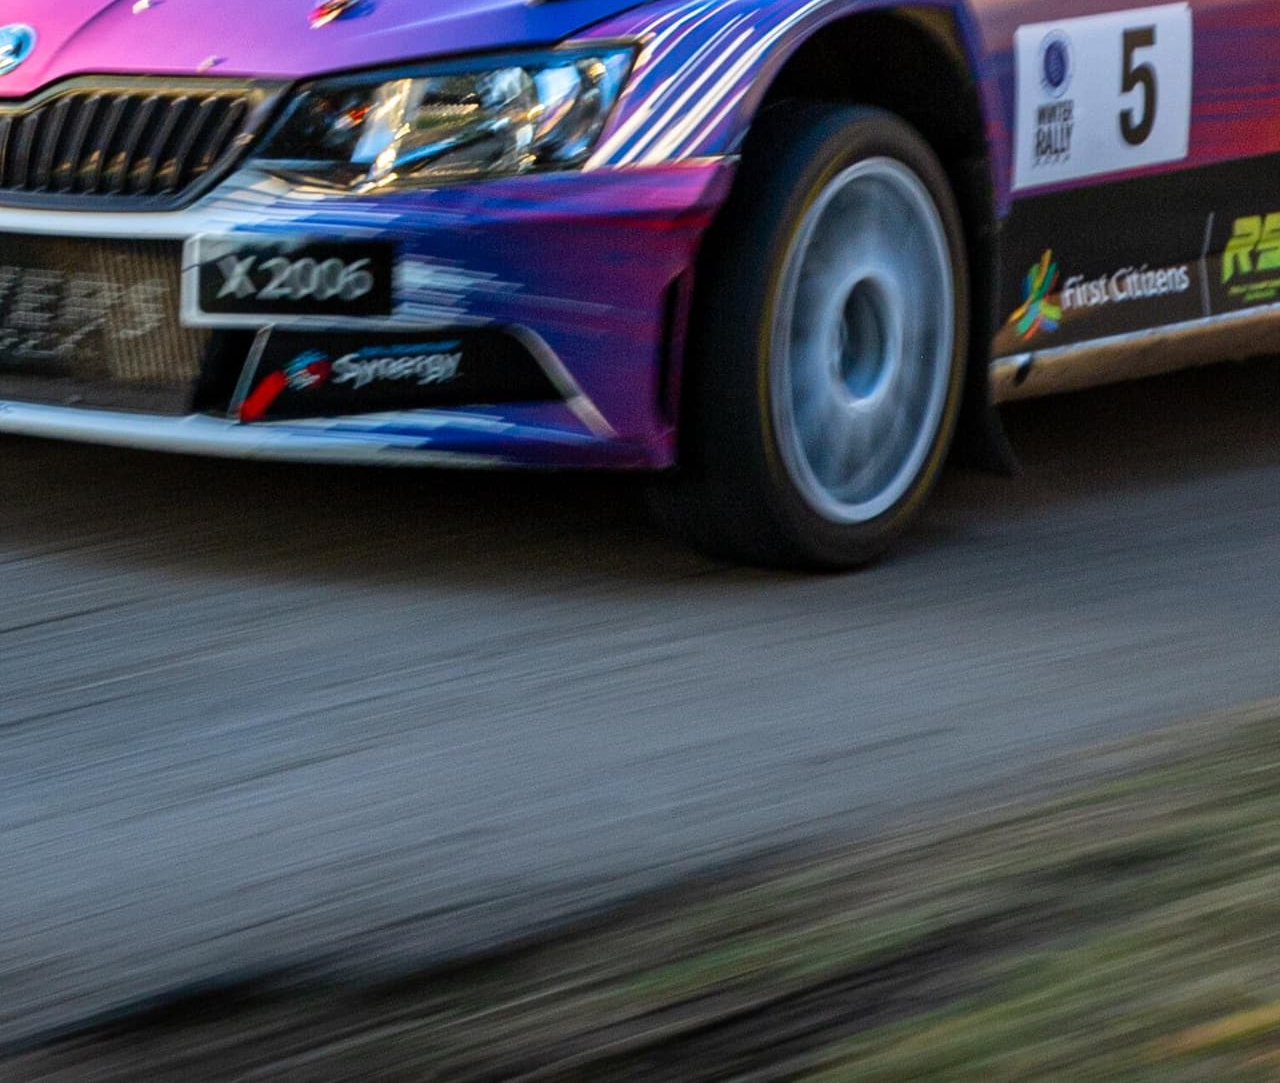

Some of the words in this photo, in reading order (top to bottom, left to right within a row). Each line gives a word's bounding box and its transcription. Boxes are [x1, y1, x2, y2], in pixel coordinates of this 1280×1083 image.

[1118, 23, 1158, 147] 5
[1036, 99, 1074, 125] WINTER
[1034, 122, 1074, 157] RALLY
[1060, 273, 1113, 311] First
[1110, 263, 1191, 303] Citizens
[331, 351, 464, 390] Synergy
